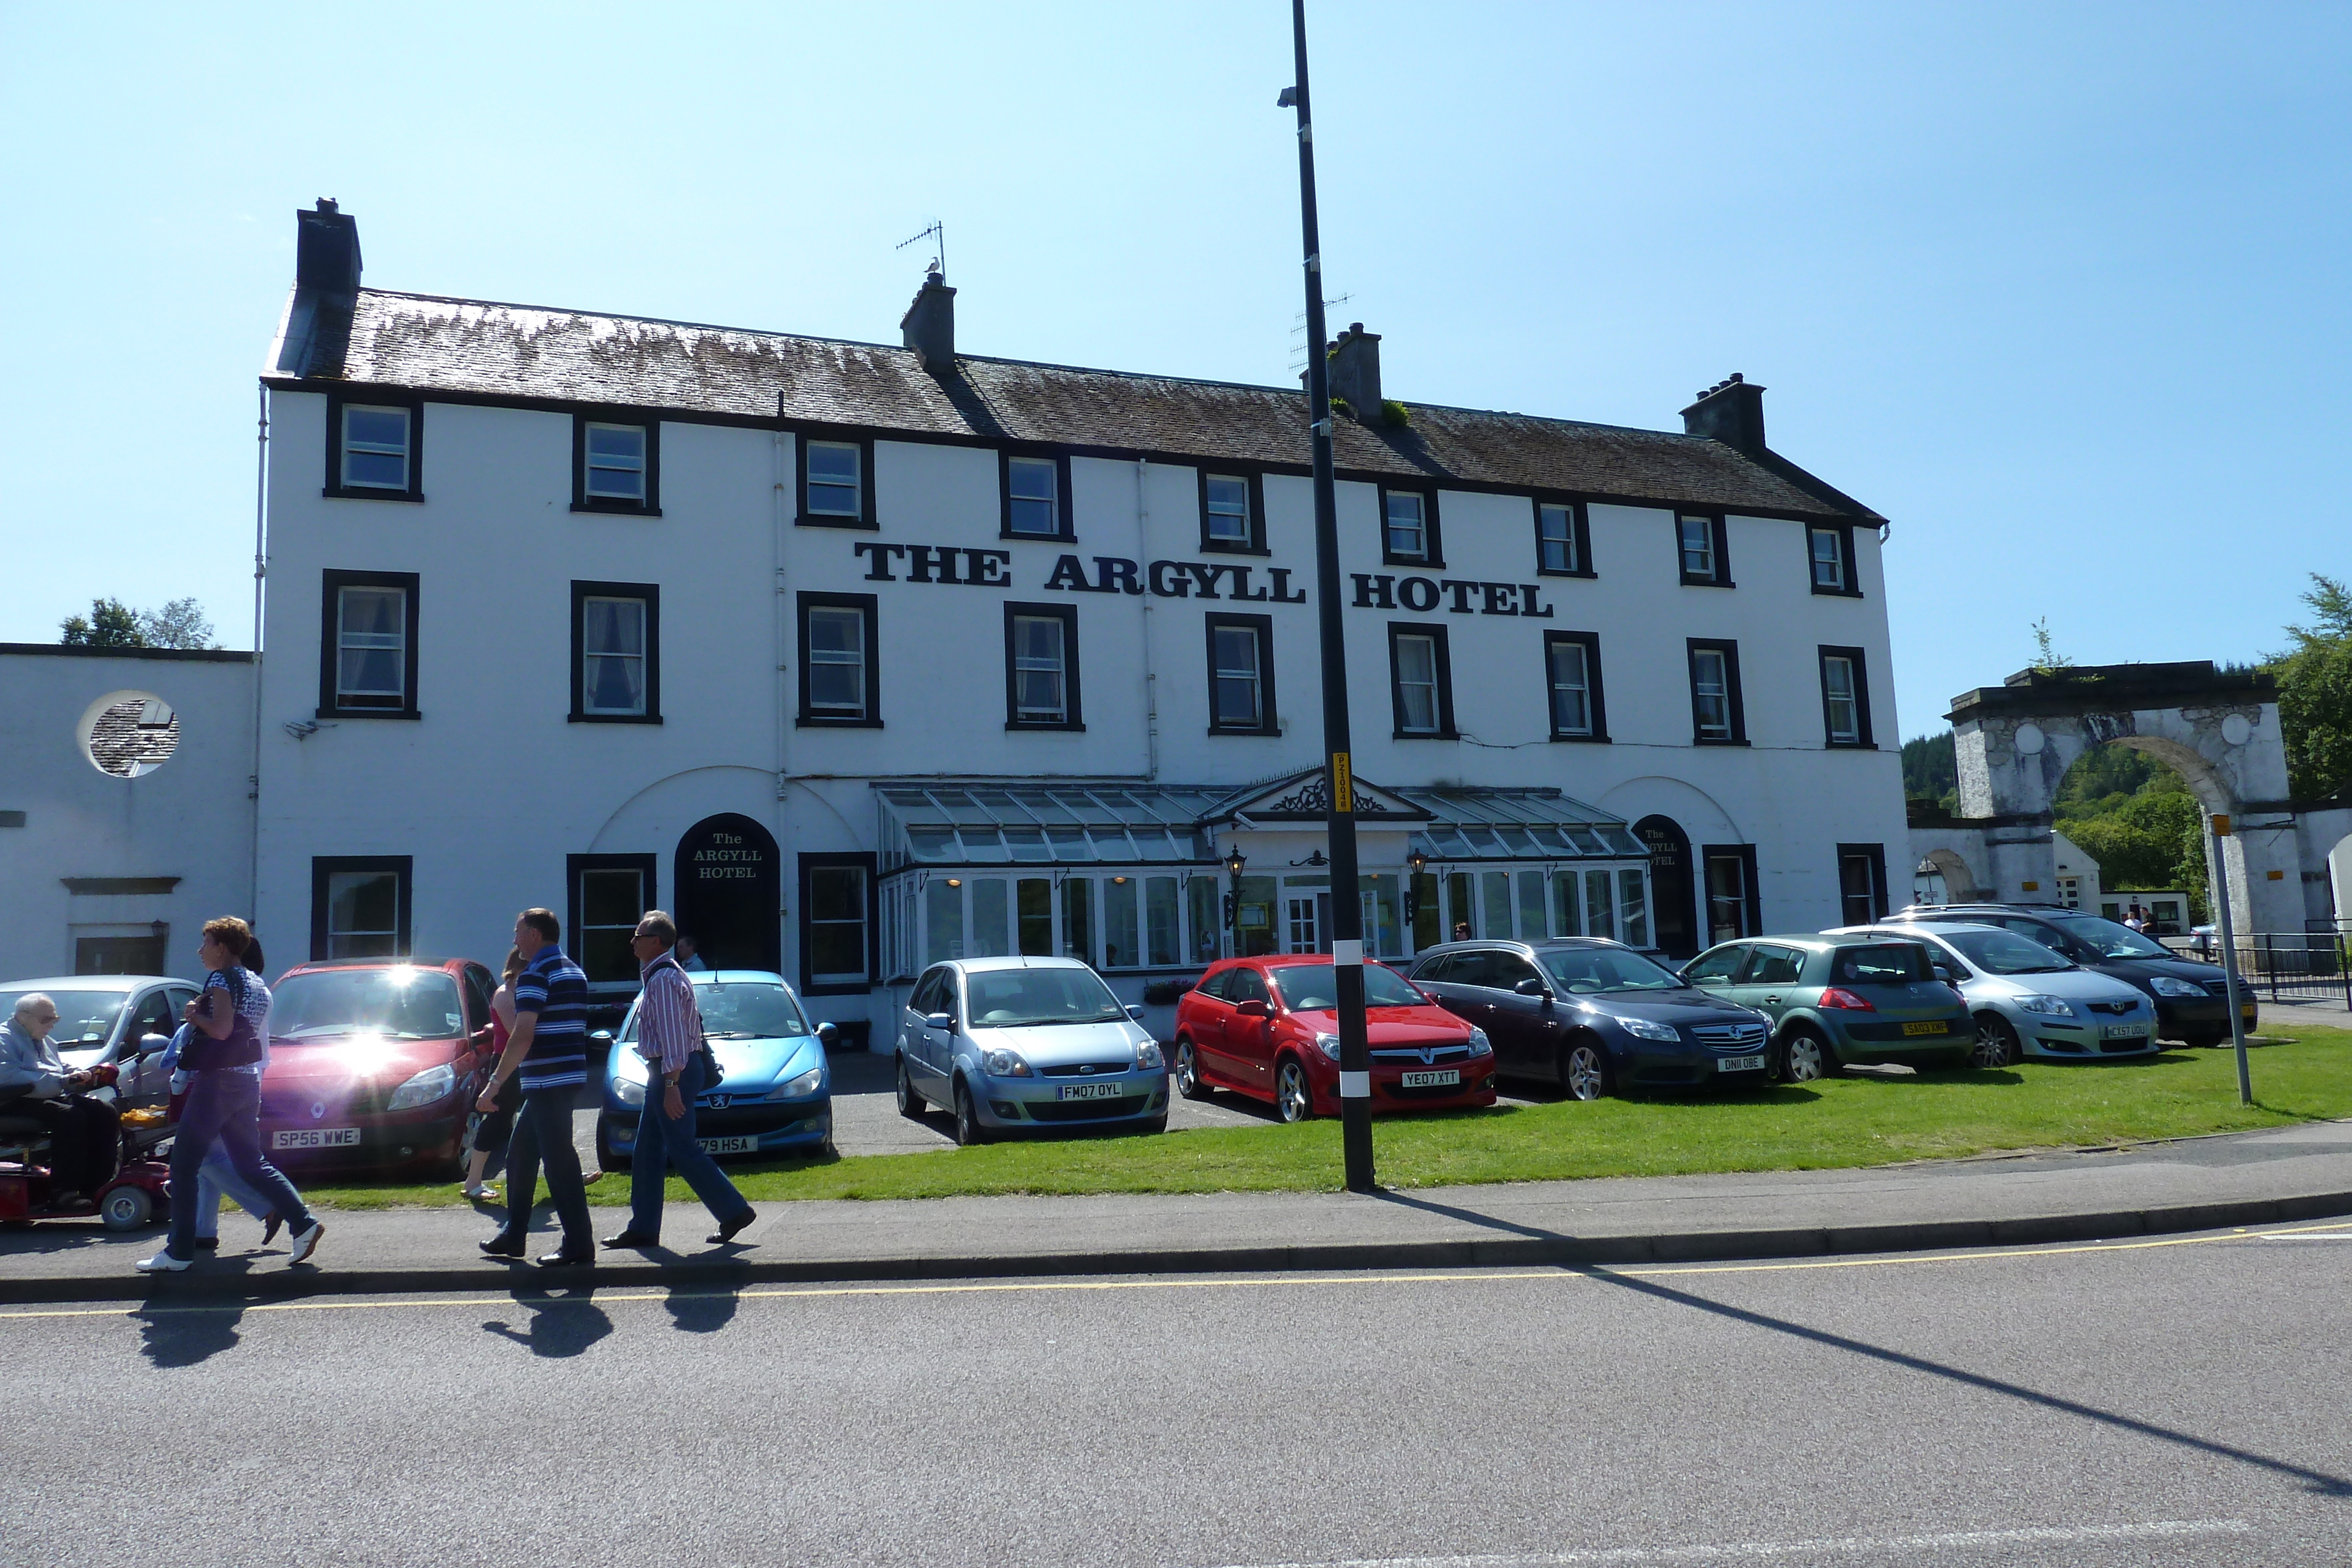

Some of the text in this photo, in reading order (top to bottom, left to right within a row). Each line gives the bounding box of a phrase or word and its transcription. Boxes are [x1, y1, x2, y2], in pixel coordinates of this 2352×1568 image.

[855, 542, 1553, 617] THE ARGYLL HOTEL
[713, 833, 742, 844] The
[1645, 830, 1664, 838] The
[1645, 843, 1678, 852] GYLL
[693, 850, 762, 861] ARGYLL
[699, 867, 756, 879] HOTEL
[1725, 1057, 1759, 1069] DN11 OBE
[1407, 1072, 1455, 1085] YE07 XTT
[1065, 1084, 1120, 1098] FM07 OYL
[279, 1131, 353, 1146] SP56 WWE
[697, 1138, 748, 1152] 79 HSA
